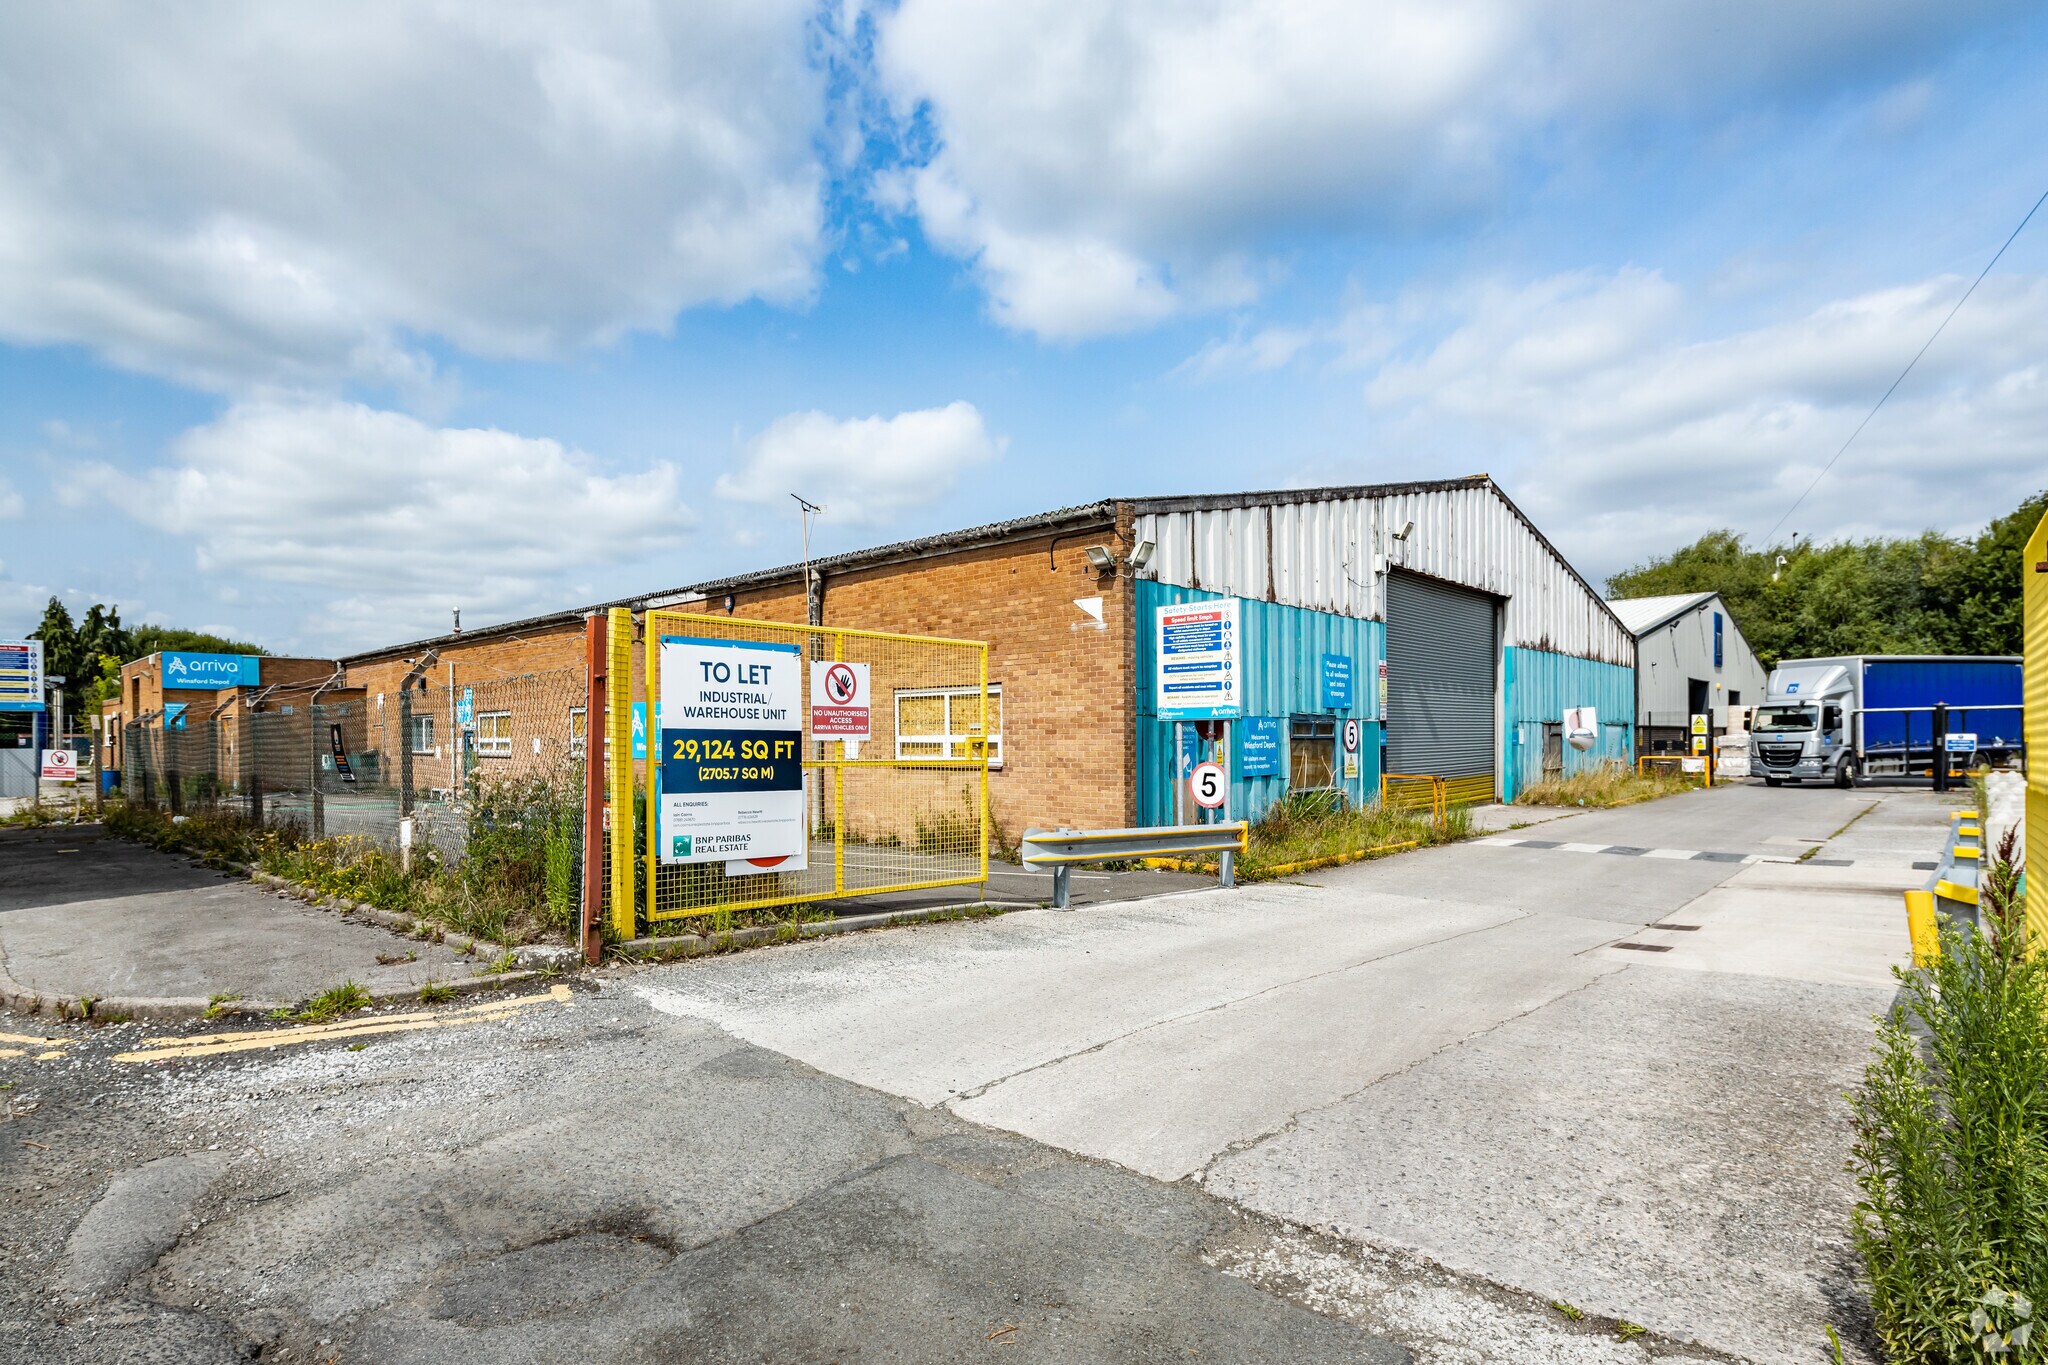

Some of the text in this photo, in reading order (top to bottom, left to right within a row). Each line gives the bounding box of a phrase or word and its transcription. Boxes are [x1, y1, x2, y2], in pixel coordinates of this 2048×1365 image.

[190, 660, 238, 672] arriva
[700, 661, 771, 685] TO LET
[700, 691, 772, 706] INDUSTRIAL/
[684, 706, 786, 720] WAREHOUSE UNIT
[1349, 727, 1354, 744] 5
[673, 739, 735, 763] 29,124
[741, 740, 768, 760] SQ
[774, 740, 795, 759] FT
[698, 766, 774, 781] (2705.7 SQ M)
[1201, 773, 1216, 797] 5
[716, 834, 751, 843] PARIBAS
[720, 843, 748, 851] ESTATE
